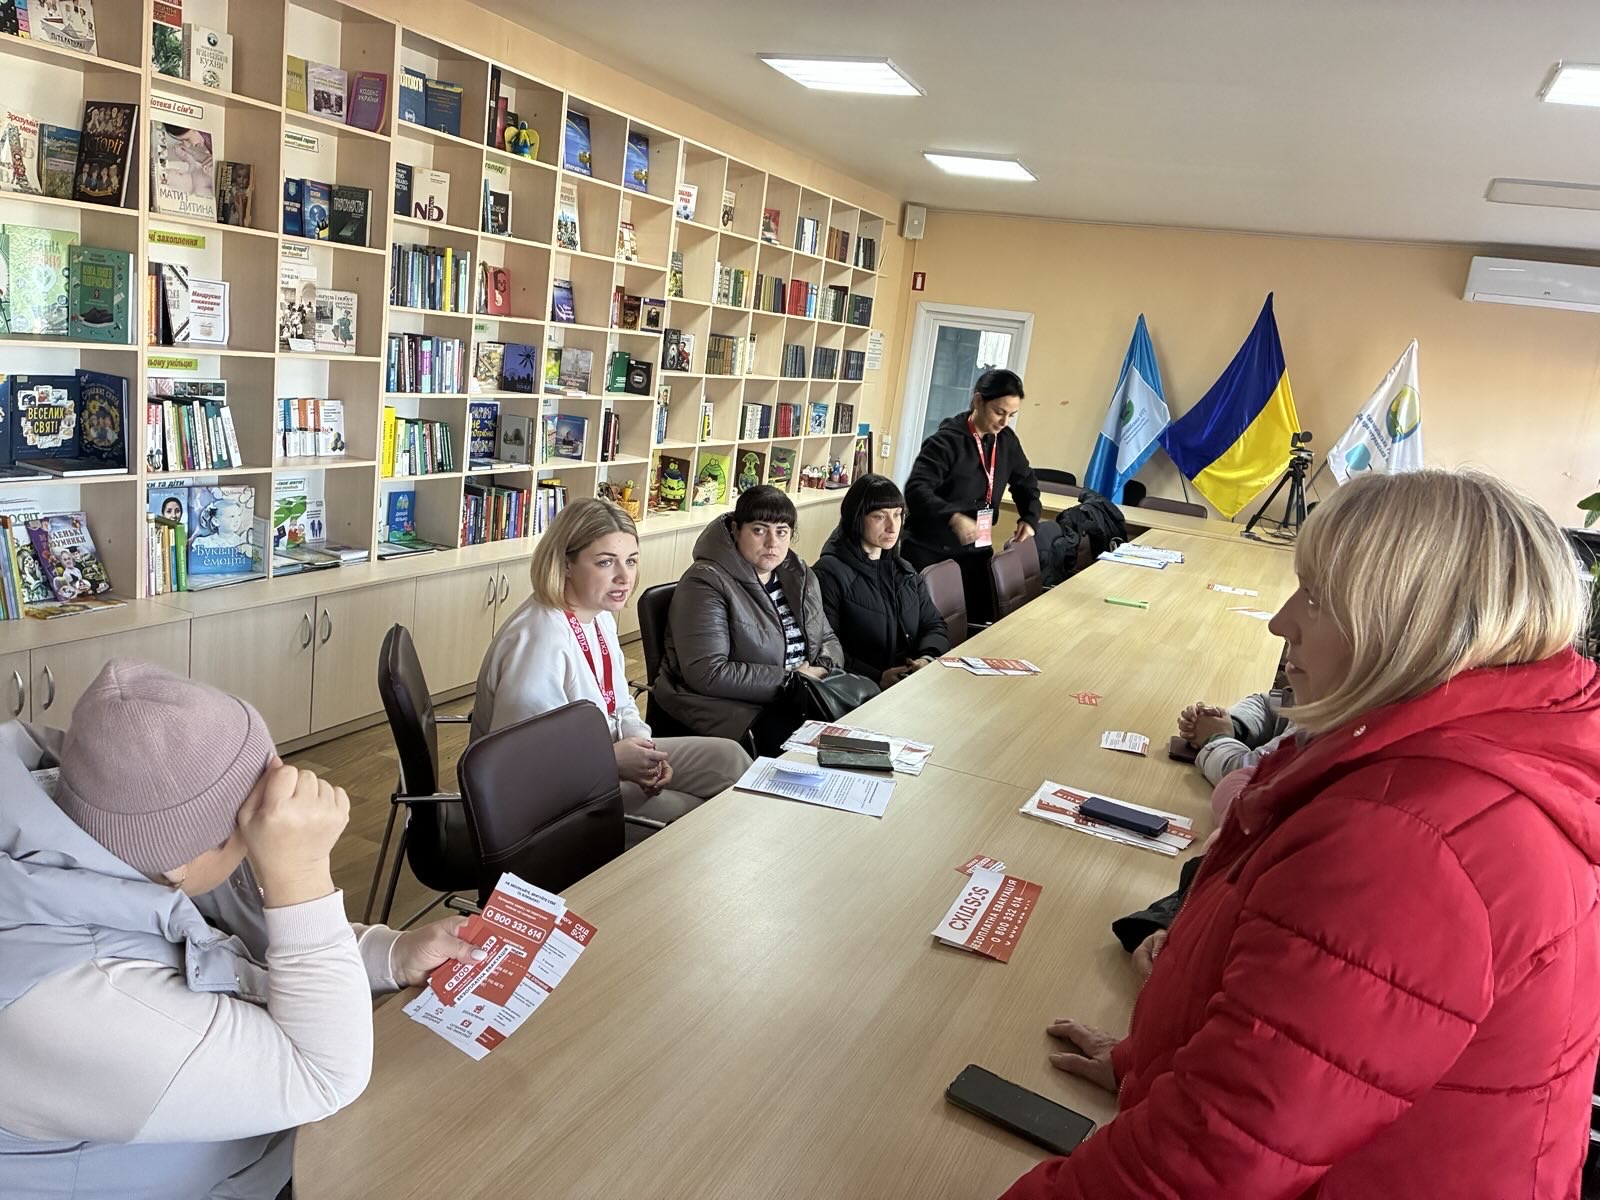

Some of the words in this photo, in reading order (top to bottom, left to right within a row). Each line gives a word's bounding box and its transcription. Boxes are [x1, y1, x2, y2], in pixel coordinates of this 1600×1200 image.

[6, 112, 38, 128] Зрозумій
[160, 188, 184, 200] МАТИ
[179, 202, 214, 215] ДИТИНА
[157, 234, 198, 246] захоплення
[28, 406, 65, 420] ВЕСЕЛИХ
[34, 420, 59, 434] СВЯТ!
[569, 617, 582, 634] SOS
[577, 632, 588, 652] СХІД
[948, 905, 978, 930] СХІД
[964, 886, 989, 907] SOS
[970, 913, 999, 949] БЕЗОПЛАТНА
[993, 879, 1017, 912] ЕВАКУАЦІЯ
[996, 922, 1009, 935] 800
[1003, 908, 1017, 921] 332
[1011, 897, 1023, 908] 614
[487, 909, 494, 918] 0
[494, 912, 512, 926] 800
[512, 919, 527, 933] 332
[528, 927, 543, 940] 614
[574, 923, 590, 935] СХІД
[571, 929, 586, 942] SOS
[454, 966, 470, 982] 800
[457, 973, 486, 1001] БЕЗОПЛАТНА
[486, 947, 508, 973] ЕВАКУАЦІЯ
